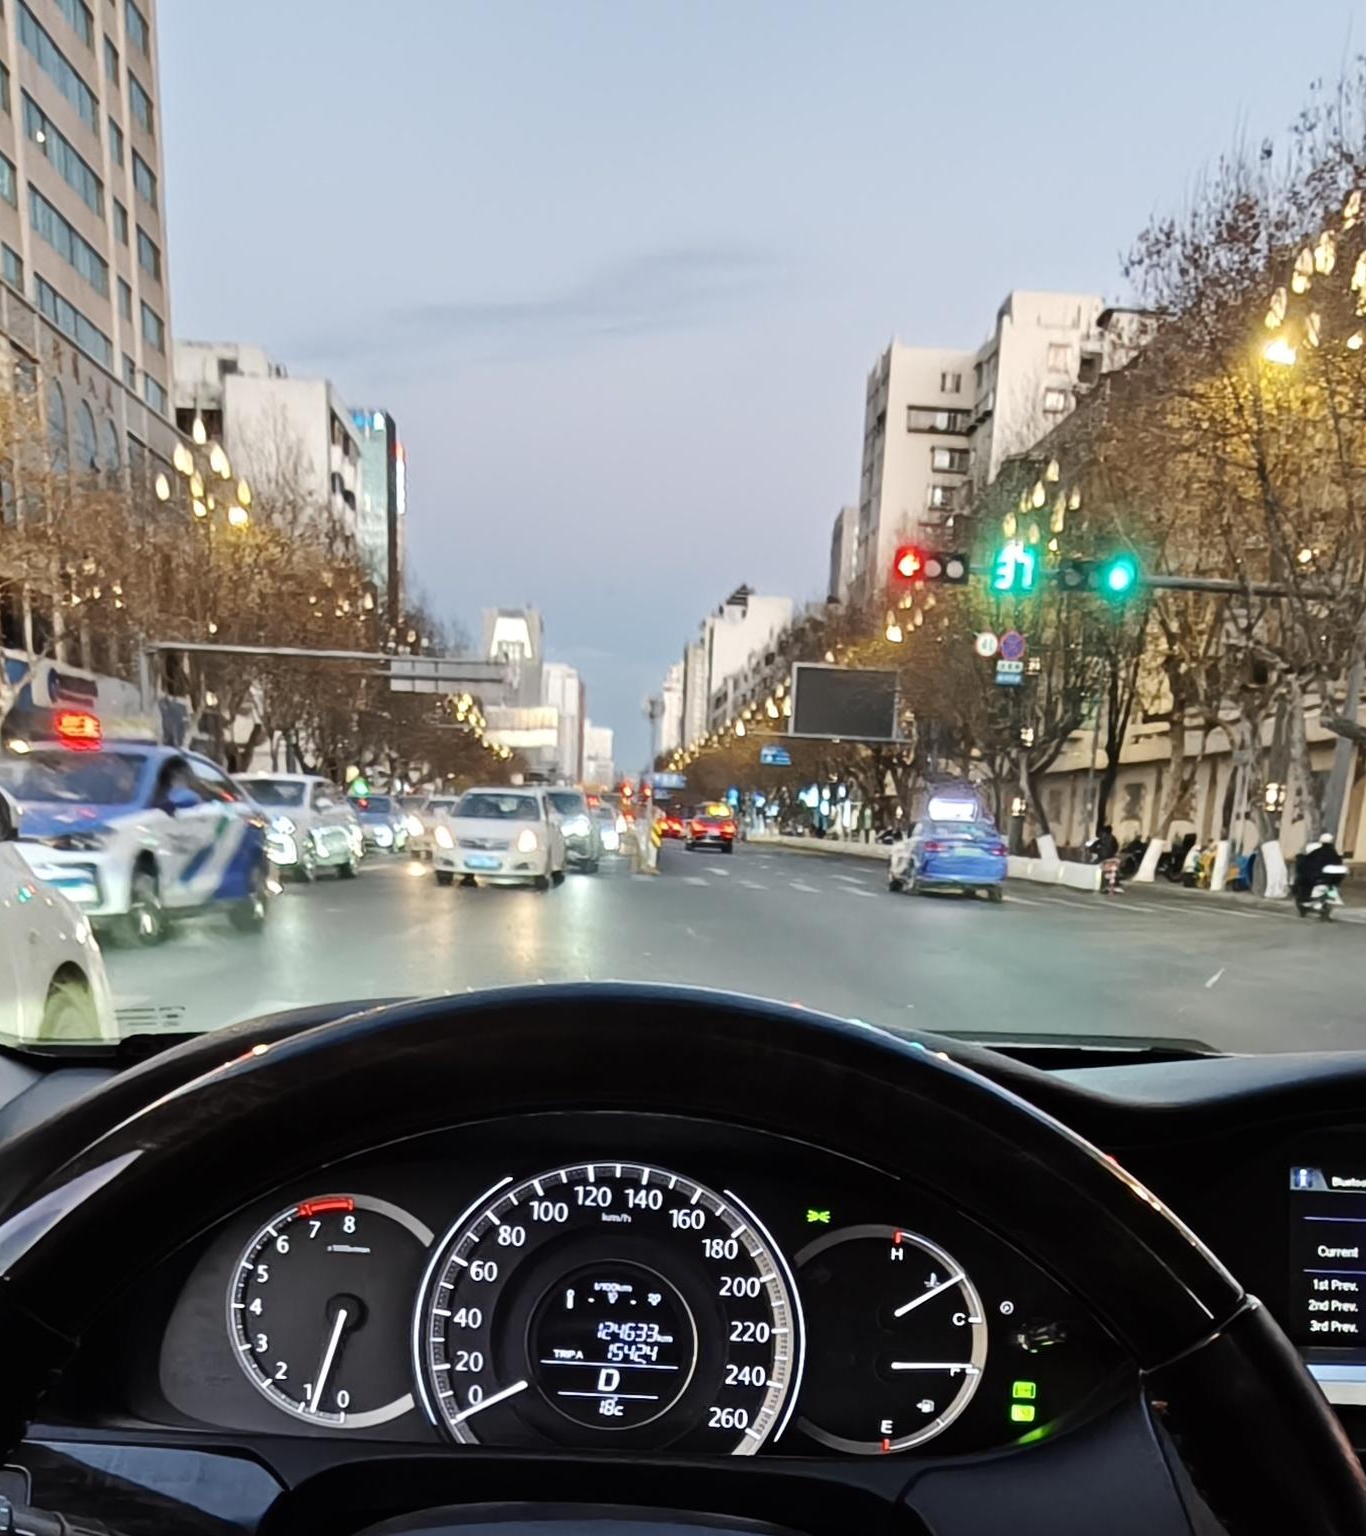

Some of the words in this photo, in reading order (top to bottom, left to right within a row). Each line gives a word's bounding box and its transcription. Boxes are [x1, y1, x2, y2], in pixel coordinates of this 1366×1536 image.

[574, 1186, 612, 1207] 120
[624, 1189, 663, 1210] 140
[529, 1202, 569, 1223] 100
[601, 1212, 632, 1224] km/h
[669, 1209, 706, 1230] 160
[309, 1221, 321, 1238] 7
[343, 1216, 356, 1233] 8
[276, 1235, 289, 1253] 6
[498, 1226, 526, 1247] 80
[701, 1239, 738, 1260] 180
[891, 1247, 903, 1260] H
[1317, 1245, 1359, 1258] Current
[257, 1265, 269, 1283] 5
[470, 1261, 498, 1282] 60
[719, 1277, 761, 1297] 200
[1313, 1279, 1329, 1291] 1st
[1331, 1279, 1359, 1292] Prev.
[249, 1298, 262, 1315] 4
[1308, 1300, 1329, 1312] 2nd
[1331, 1300, 1359, 1312] Prev.
[453, 1308, 482, 1329] 40
[952, 1313, 965, 1326] C
[1310, 1320, 1329, 1332] 3rd
[1331, 1321, 1359, 1333] Prev.
[597, 1321, 659, 1343] 124633
[729, 1322, 770, 1343] 220
[255, 1334, 268, 1352] 3
[455, 1351, 483, 1372] 20
[275, 1362, 288, 1380] 2
[597, 1368, 621, 1392] D
[725, 1365, 765, 1386] 240
[303, 1384, 313, 1400] 1
[337, 1390, 350, 1408] 0
[468, 1385, 483, 1405] 0
[708, 1407, 748, 1429] 260
[881, 1420, 893, 1433] E
